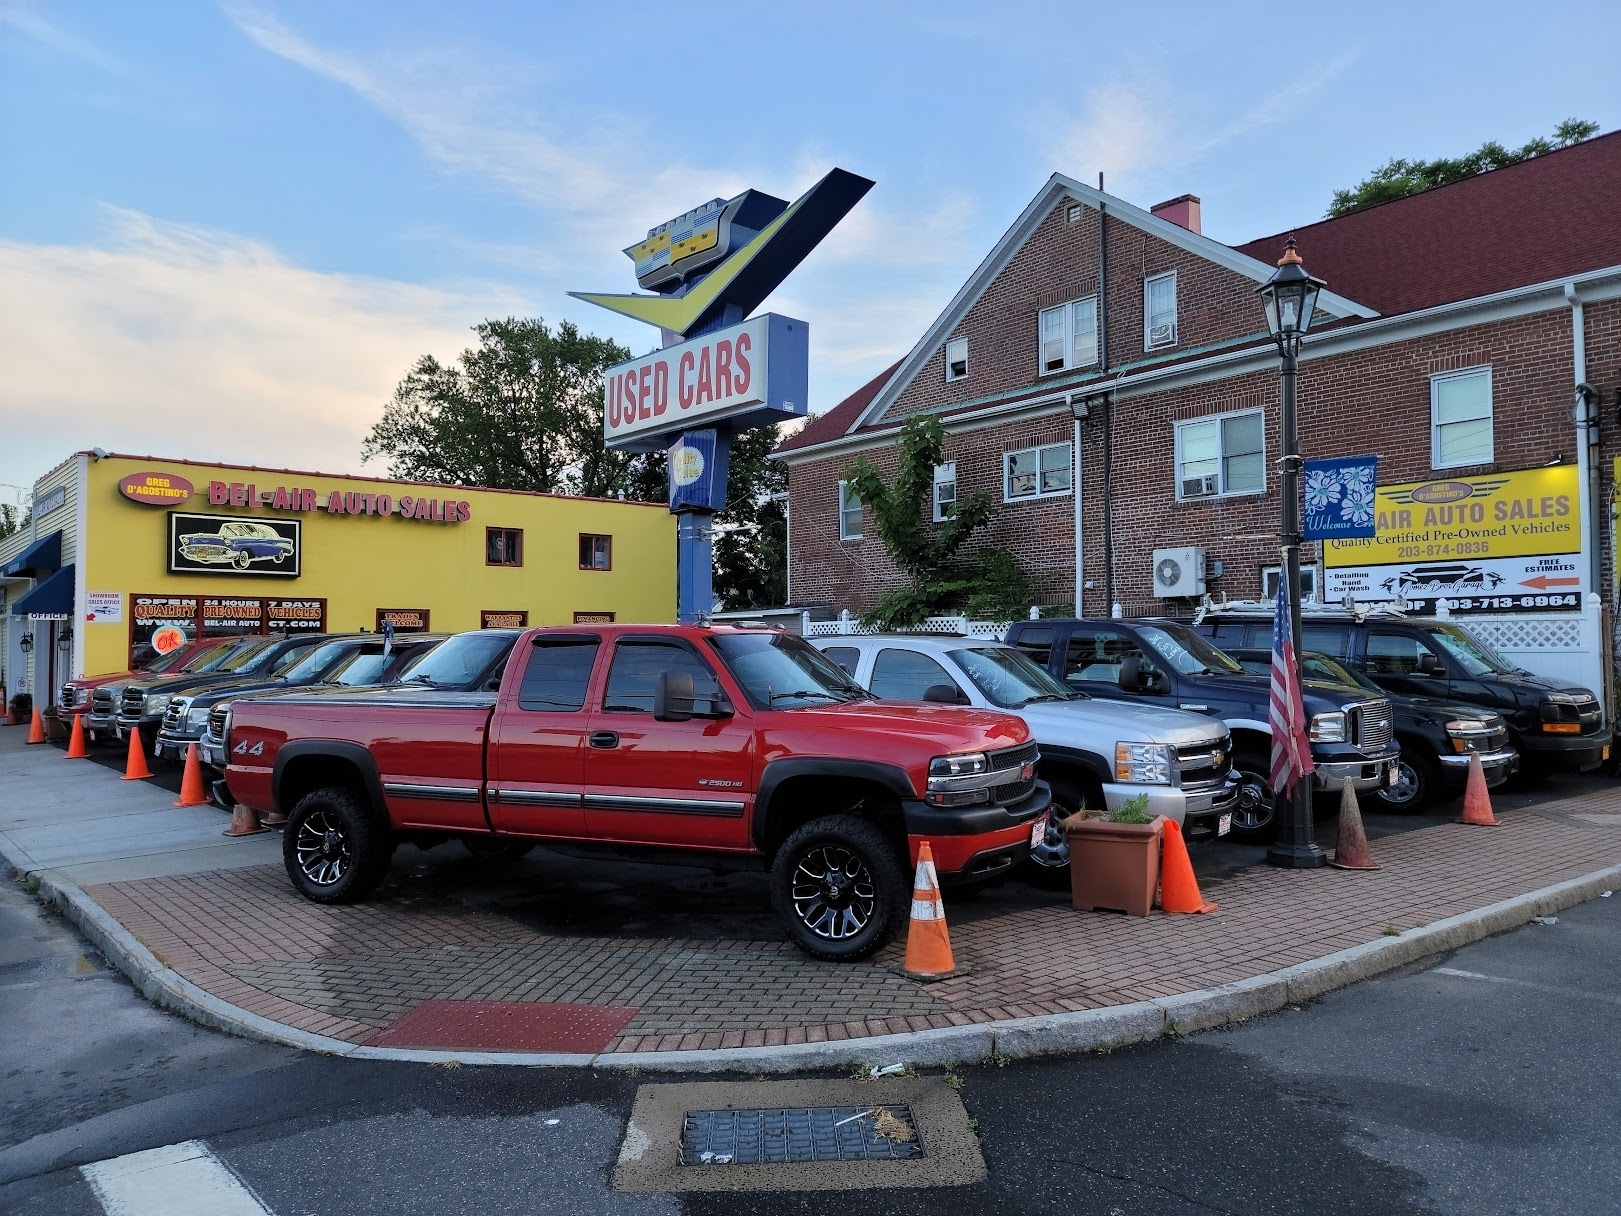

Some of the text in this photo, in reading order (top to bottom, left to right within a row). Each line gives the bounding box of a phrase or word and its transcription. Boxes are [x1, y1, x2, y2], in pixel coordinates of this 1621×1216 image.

[609, 332, 752, 428] USED CARS
[146, 477, 170, 487] GREG
[127, 484, 189, 498] D'AGOSTINO'S
[209, 480, 471, 522] BEL-AIR AUTO SALES
[1424, 502, 1485, 527] AUTO
[1494, 494, 1570, 522] SALES
[1305, 515, 1352, 530] Welcome
[1331, 520, 1571, 550] Quality Certified Pre-Owned Vehicles
[1397, 541, 1489, 558] 203-874-0836
[1525, 564, 1575, 573] ESTIMATES
[1453, 577, 1485, 594] Garage
[1436, 595, 1577, 609] 03-713-6964
[134, 604, 322, 619] QUALITY PRE-OWNED VEHICLES
[385, 612, 420, 620] TRADES
[381, 619, 423, 627] WLCOME
